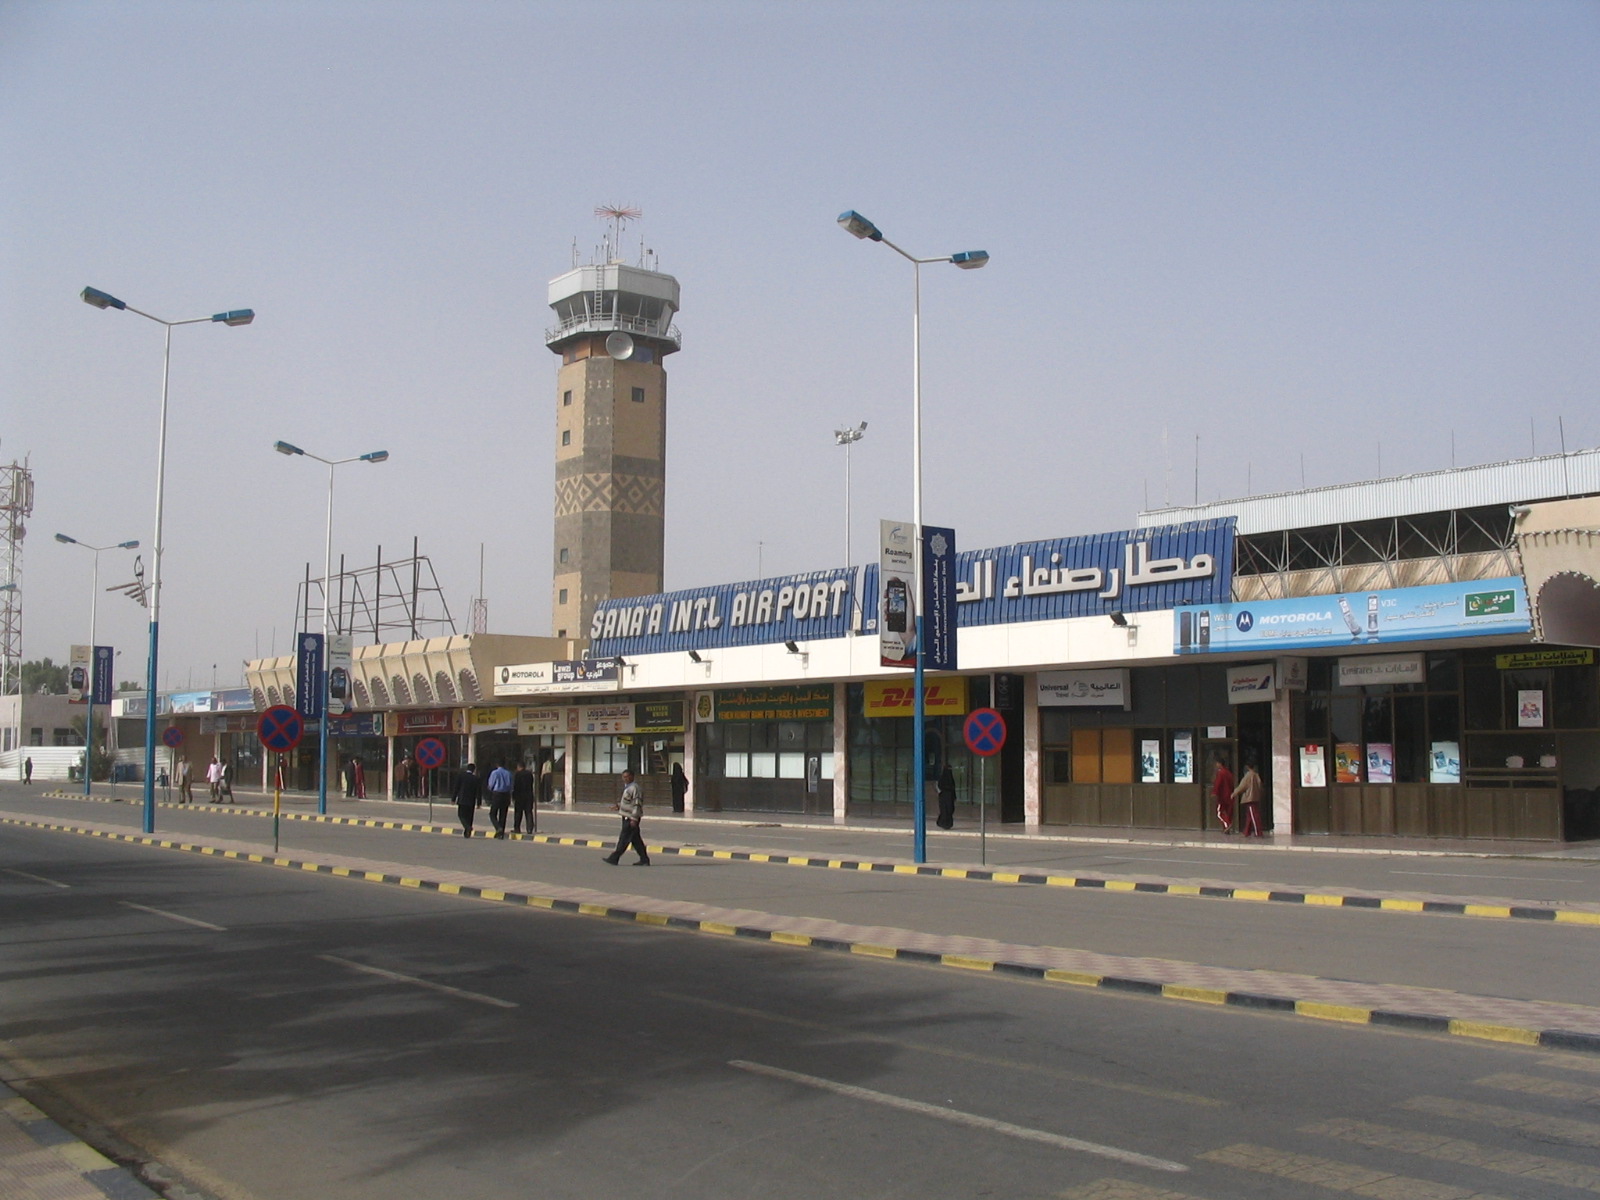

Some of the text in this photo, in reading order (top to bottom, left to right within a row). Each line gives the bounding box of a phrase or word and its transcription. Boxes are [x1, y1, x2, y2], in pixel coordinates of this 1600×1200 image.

[885, 547, 912, 559] Roaming
[1003, 552, 1103, 598] صنعاء
[1099, 541, 1214, 598] مطار
[590, 603, 662, 640] SANA'A
[731, 579, 848, 626] AIRPORT
[1259, 612, 1332, 624] MOTOROLA
[511, 670, 544, 679] MOTOROLA
[557, 672, 575, 682] group
[1342, 666, 1373, 676] Emirates
[1040, 683, 1069, 691] Universal
[881, 686, 945, 707] DHL
